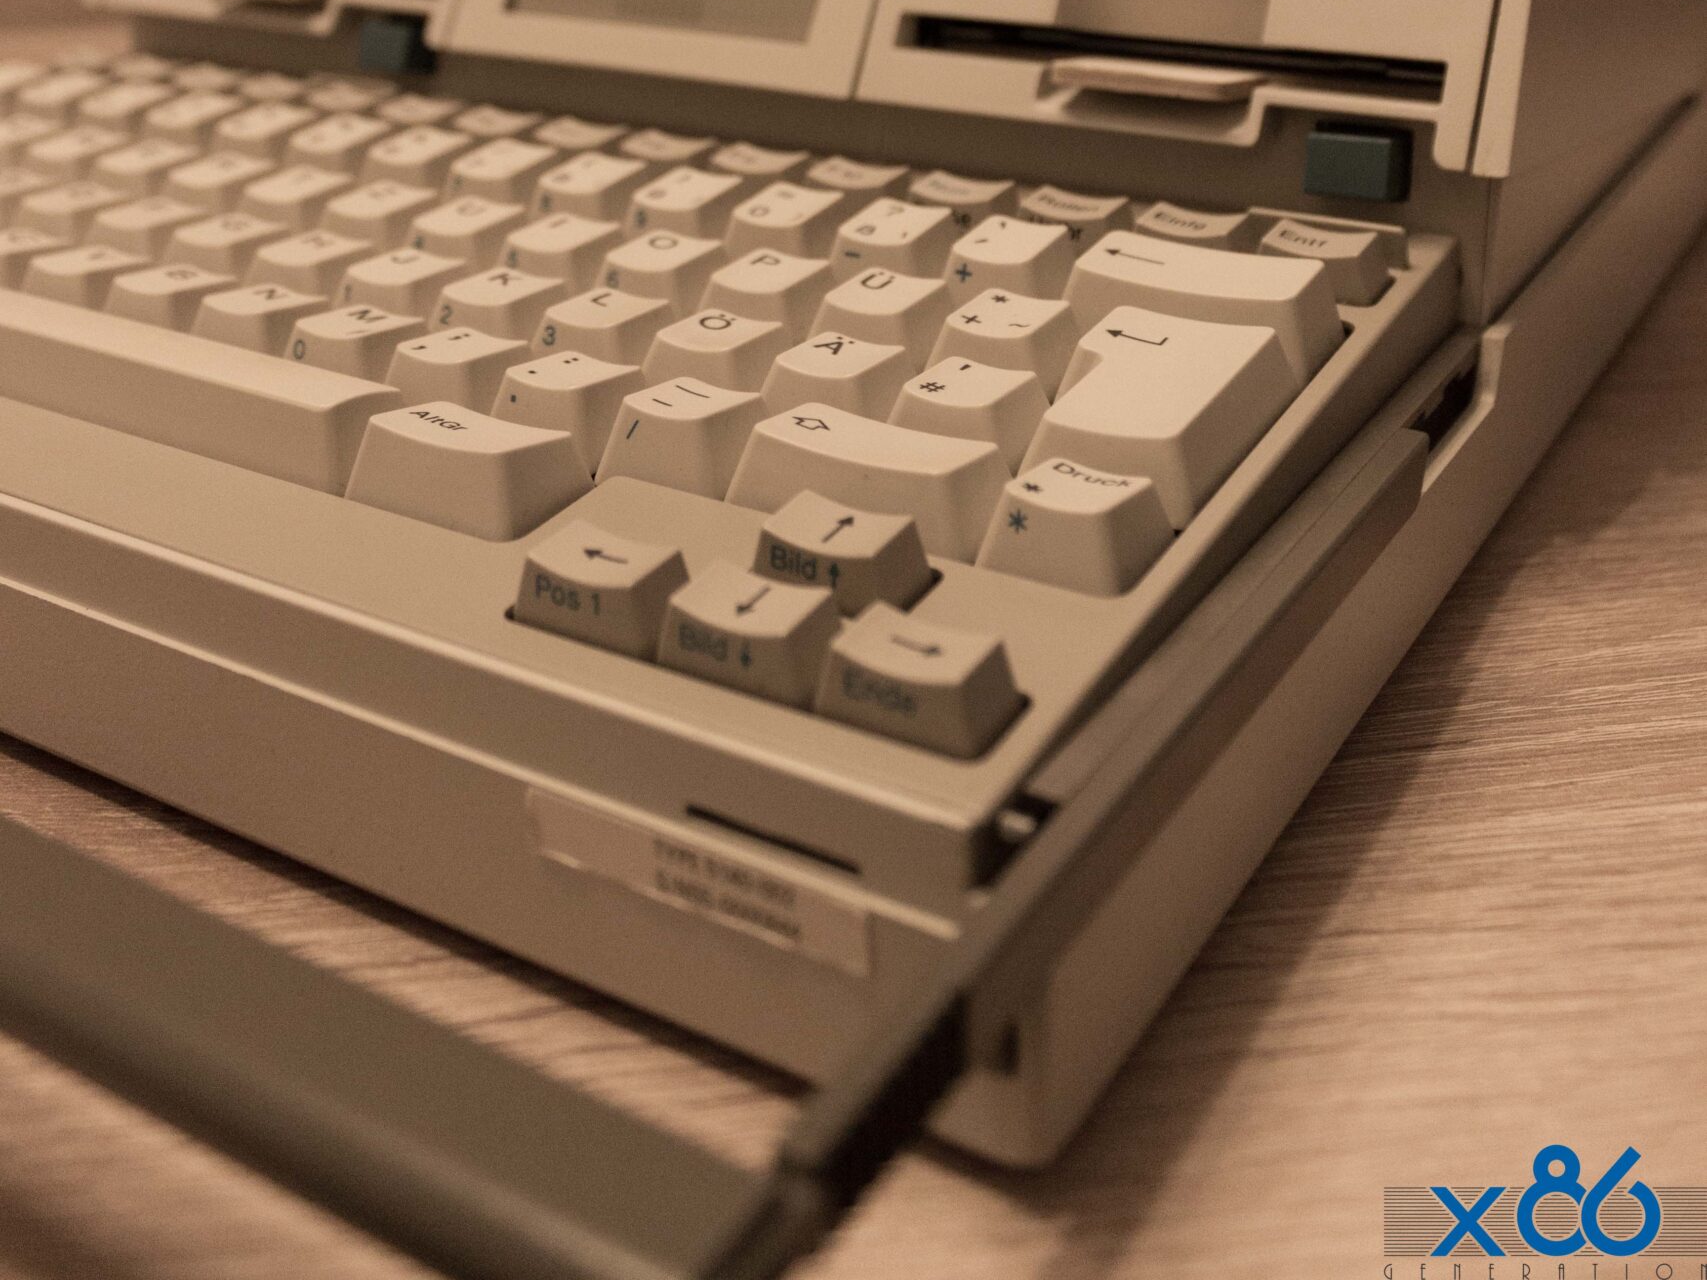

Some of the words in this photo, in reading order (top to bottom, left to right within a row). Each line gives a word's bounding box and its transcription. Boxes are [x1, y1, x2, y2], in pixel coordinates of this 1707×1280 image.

[1278, 227, 1328, 250] Entf
[750, 254, 781, 266] P
[860, 270, 896, 291] Ü
[590, 292, 613, 308] L
[699, 313, 737, 331] Ö
[541, 324, 557, 347] 3
[813, 336, 856, 356] Ä
[408, 409, 470, 432] AltGr
[1052, 462, 1132, 488] Druck
[767, 543, 818, 582] Bild
[534, 573, 581, 612] Pos
[677, 621, 730, 663] Bild
